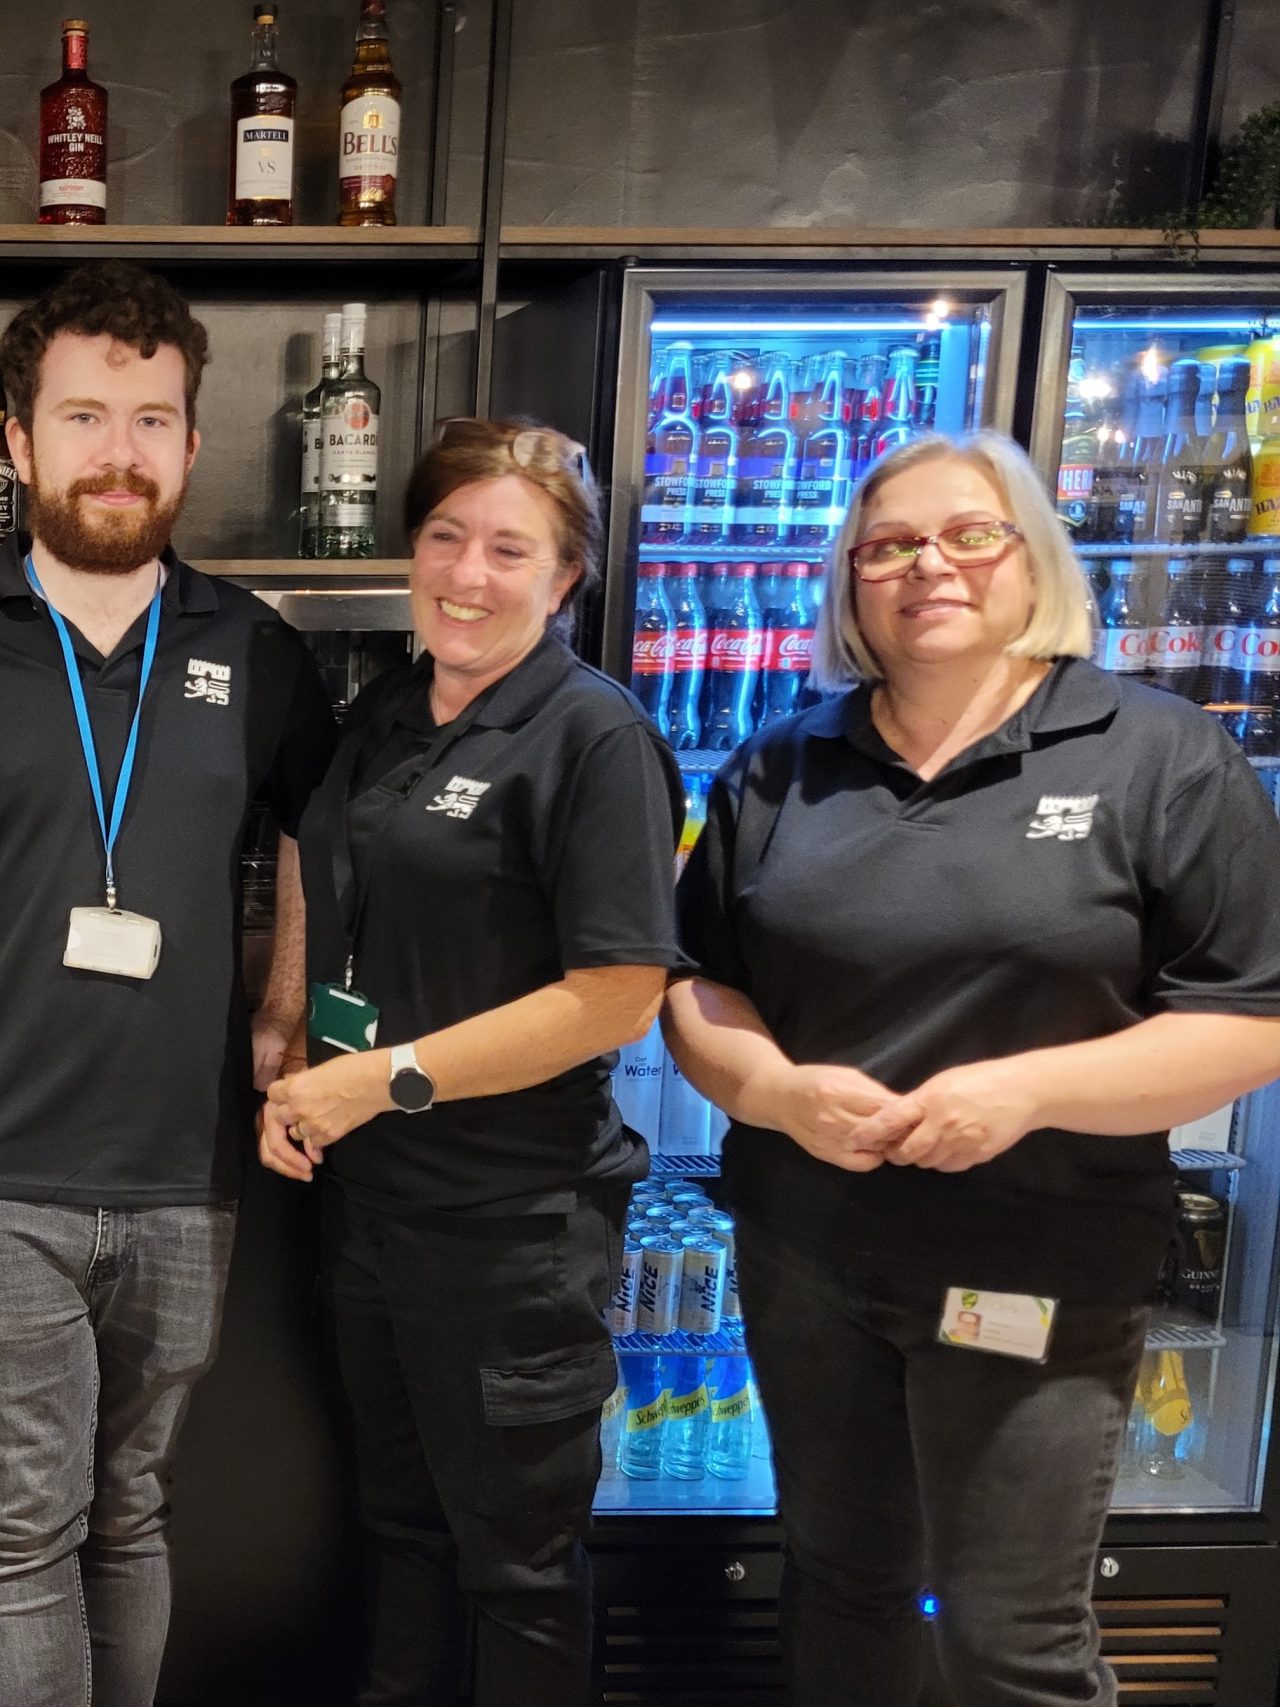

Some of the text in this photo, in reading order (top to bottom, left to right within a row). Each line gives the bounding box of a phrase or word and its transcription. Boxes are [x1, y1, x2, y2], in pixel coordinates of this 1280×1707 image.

[47, 132, 103, 145] WHITLEY NEILL
[245, 129, 288, 141] MARTELL
[68, 142, 85, 153] GIN
[342, 131, 398, 156] BELL'S
[257, 160, 277, 175] VS
[624, 1064, 662, 1077] Water
